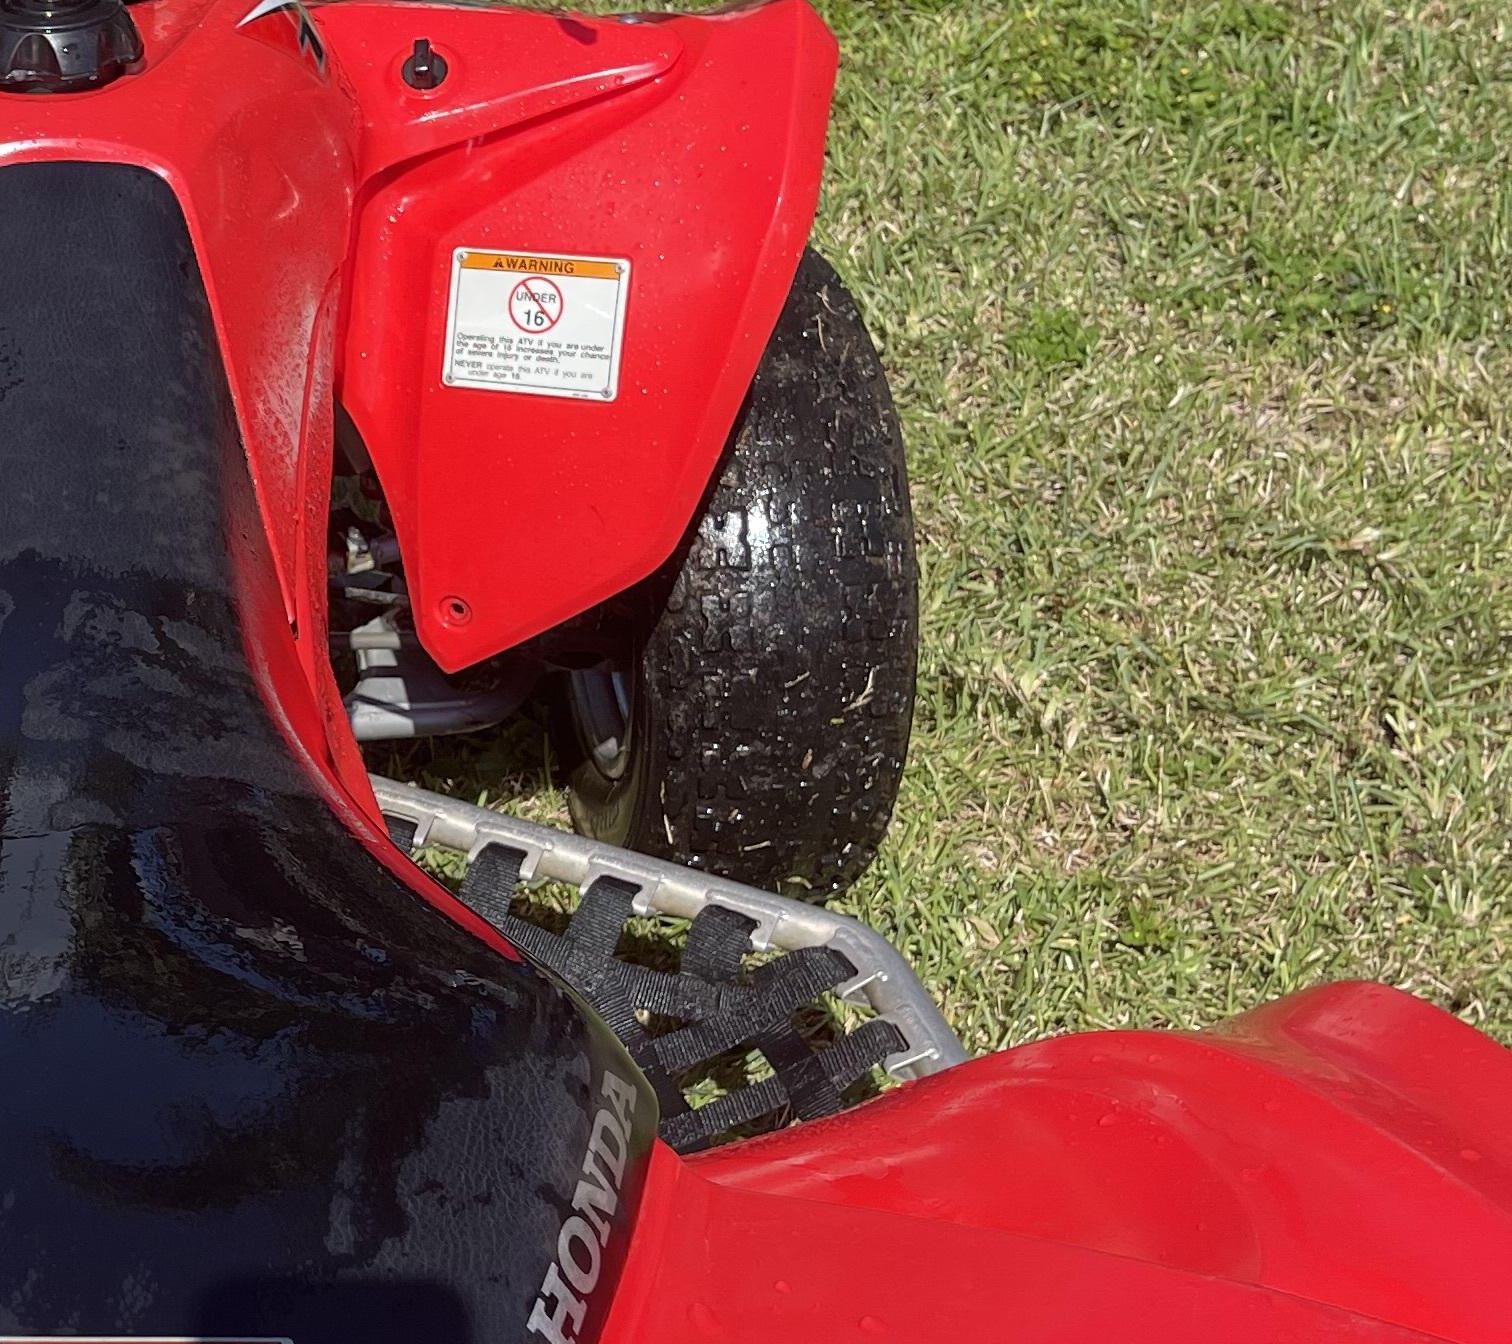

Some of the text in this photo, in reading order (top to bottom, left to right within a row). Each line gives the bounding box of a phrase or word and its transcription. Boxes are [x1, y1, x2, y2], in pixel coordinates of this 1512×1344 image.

[506, 257, 574, 274] WARNING
[515, 291, 556, 304] UNDER
[523, 308, 545, 327] 16
